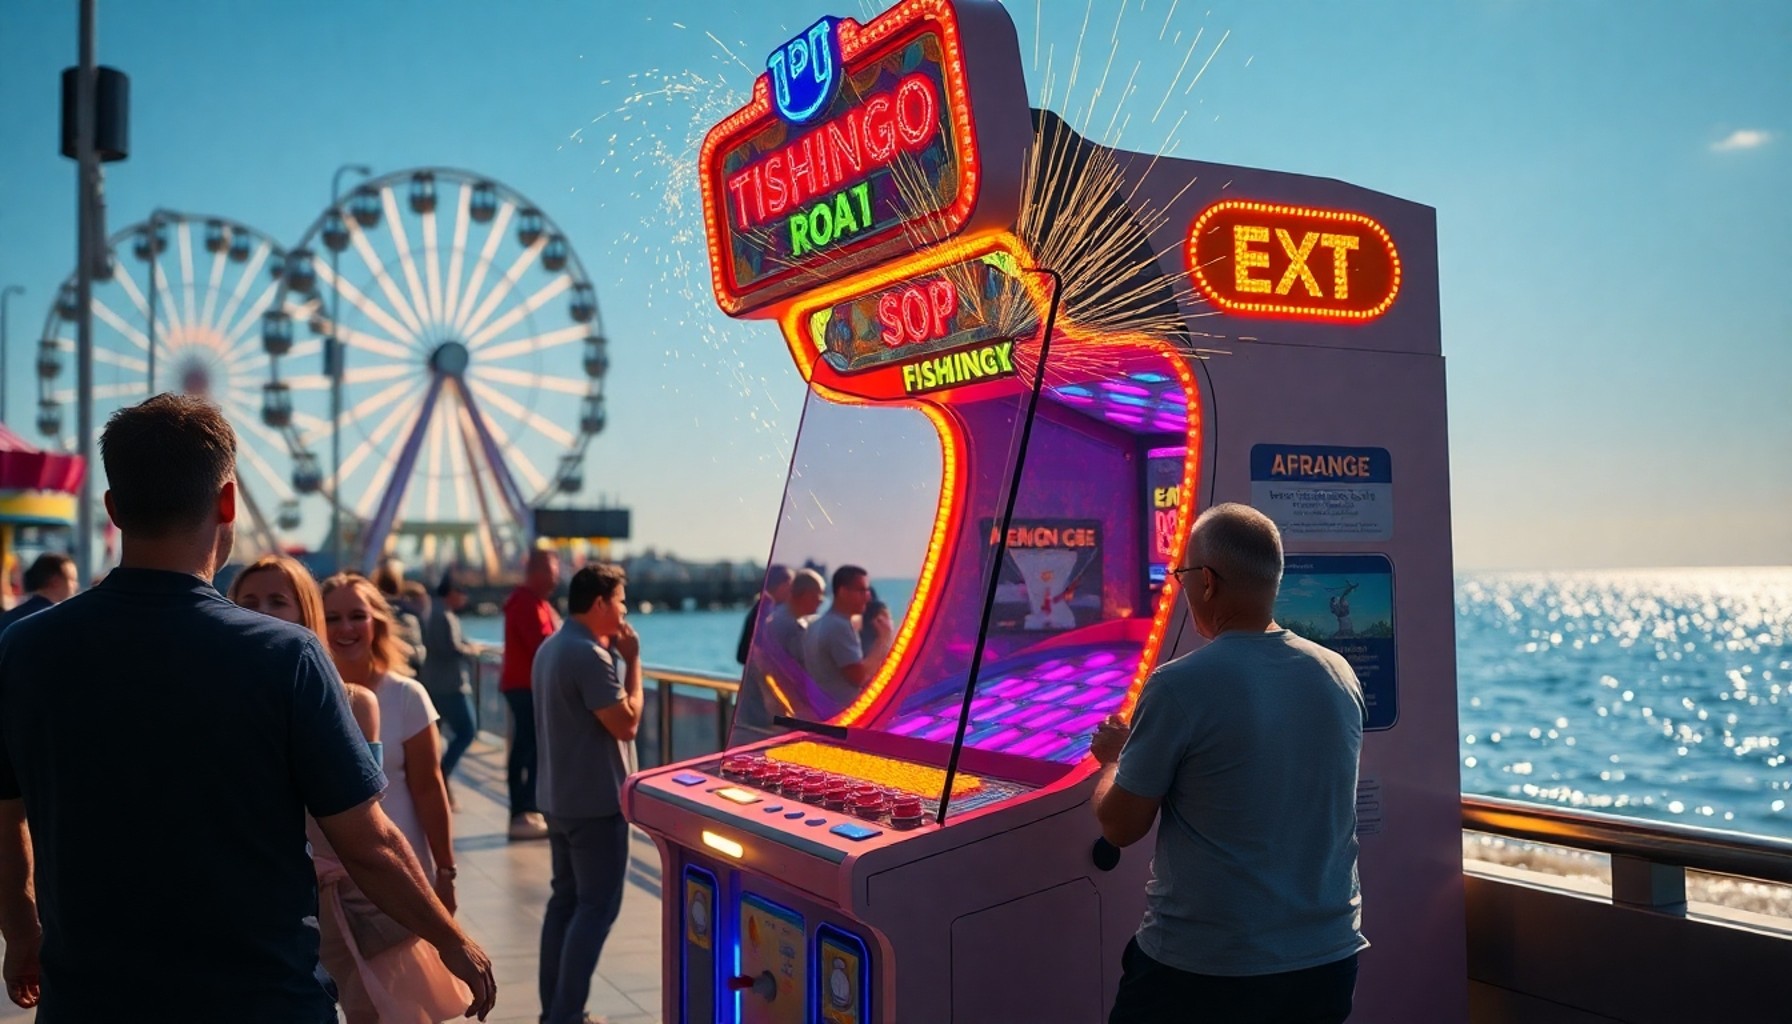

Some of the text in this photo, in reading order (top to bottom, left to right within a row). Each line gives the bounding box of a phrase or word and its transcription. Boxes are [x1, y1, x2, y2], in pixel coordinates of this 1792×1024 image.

[729, 78, 933, 230] TISHINGO
[1233, 225, 1360, 299] EXT
[877, 280, 957, 347] SOP
[1271, 453, 1371, 478] AFRANGE
